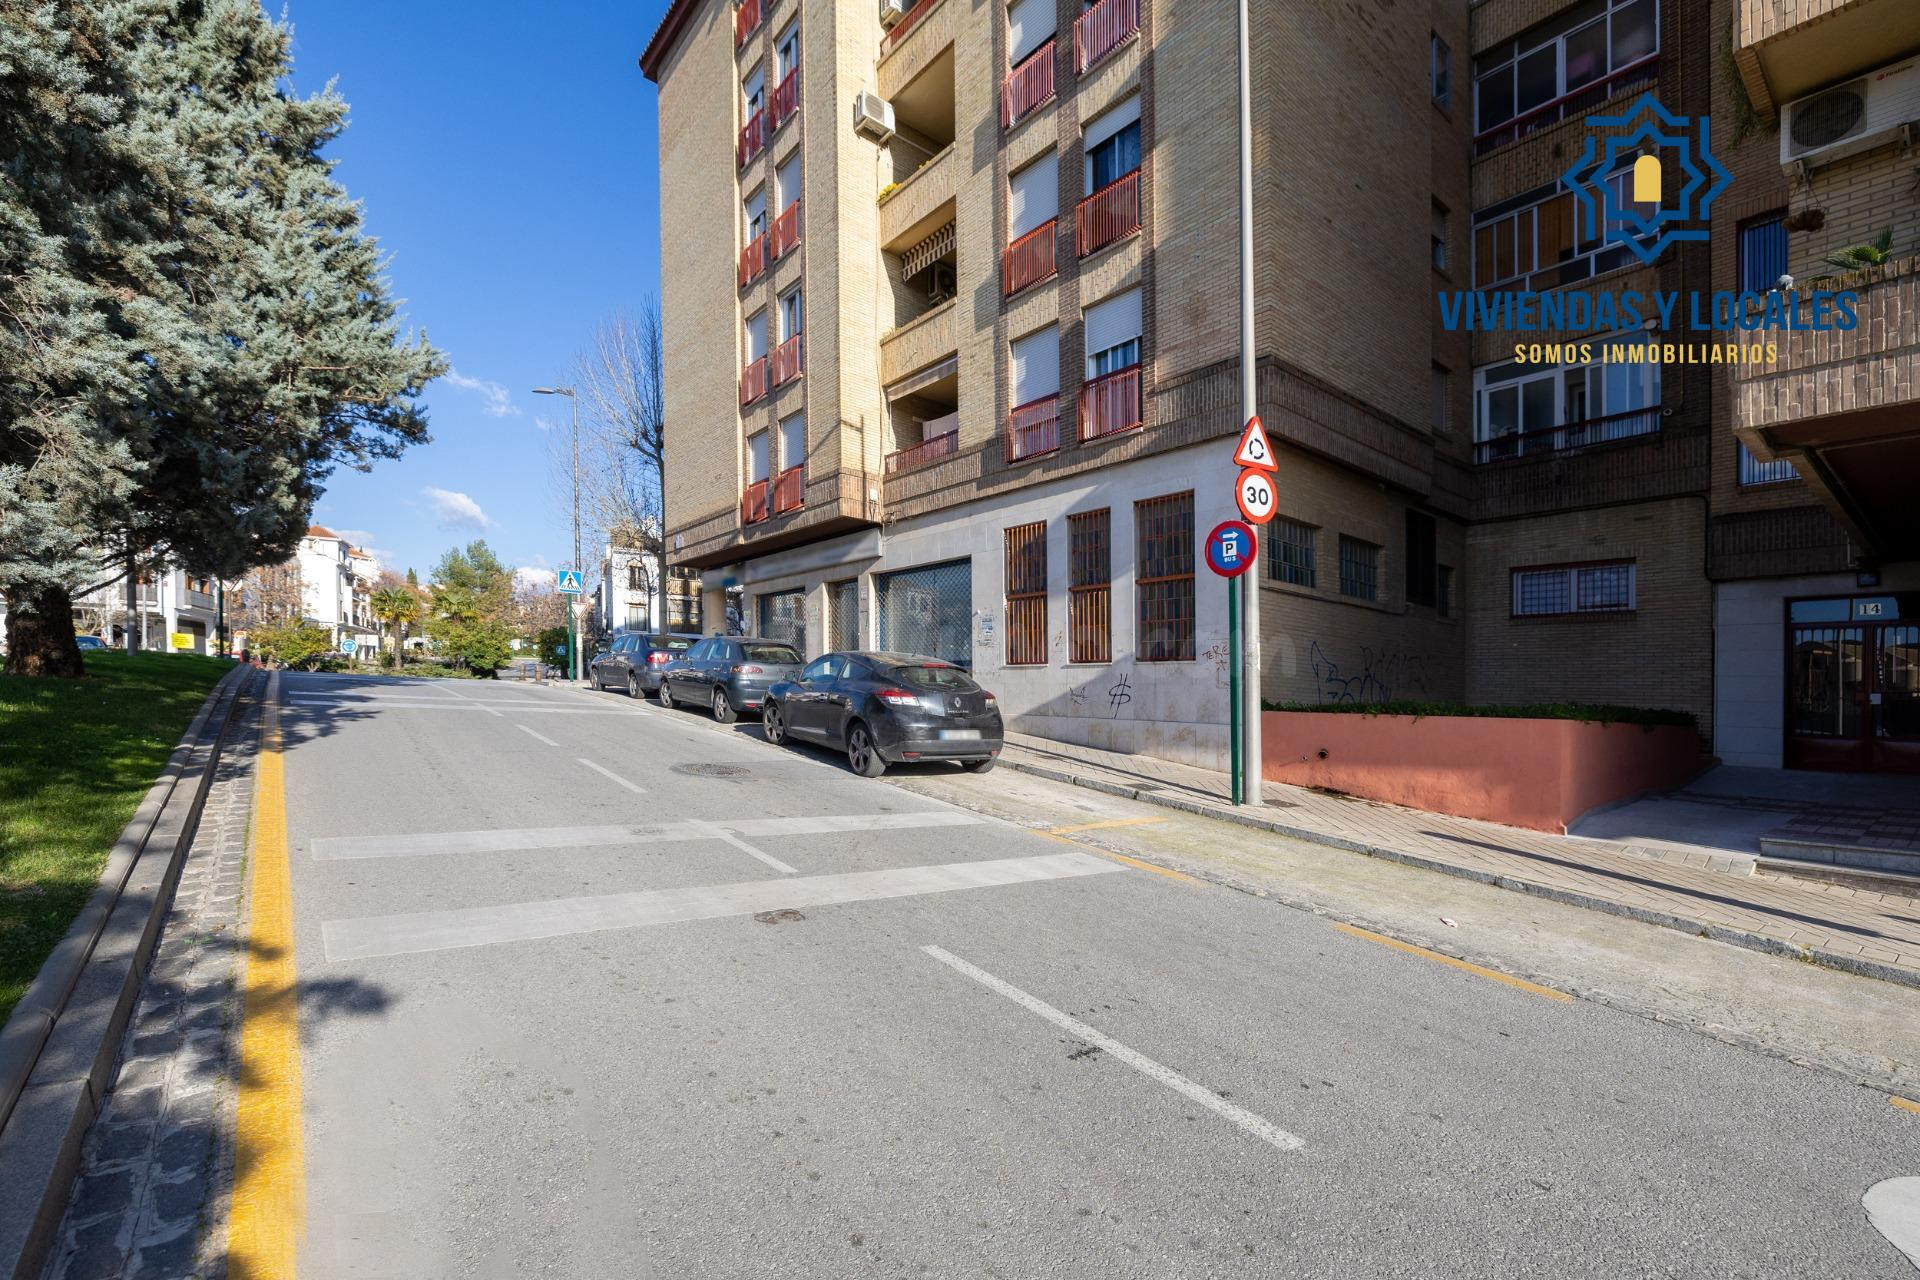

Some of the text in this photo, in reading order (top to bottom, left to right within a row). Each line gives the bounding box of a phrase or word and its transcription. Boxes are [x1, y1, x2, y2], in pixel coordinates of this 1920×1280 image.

[1246, 486, 1269, 505] 30
[1225, 543, 1234, 554] P
[1862, 604, 1881, 615] 14
